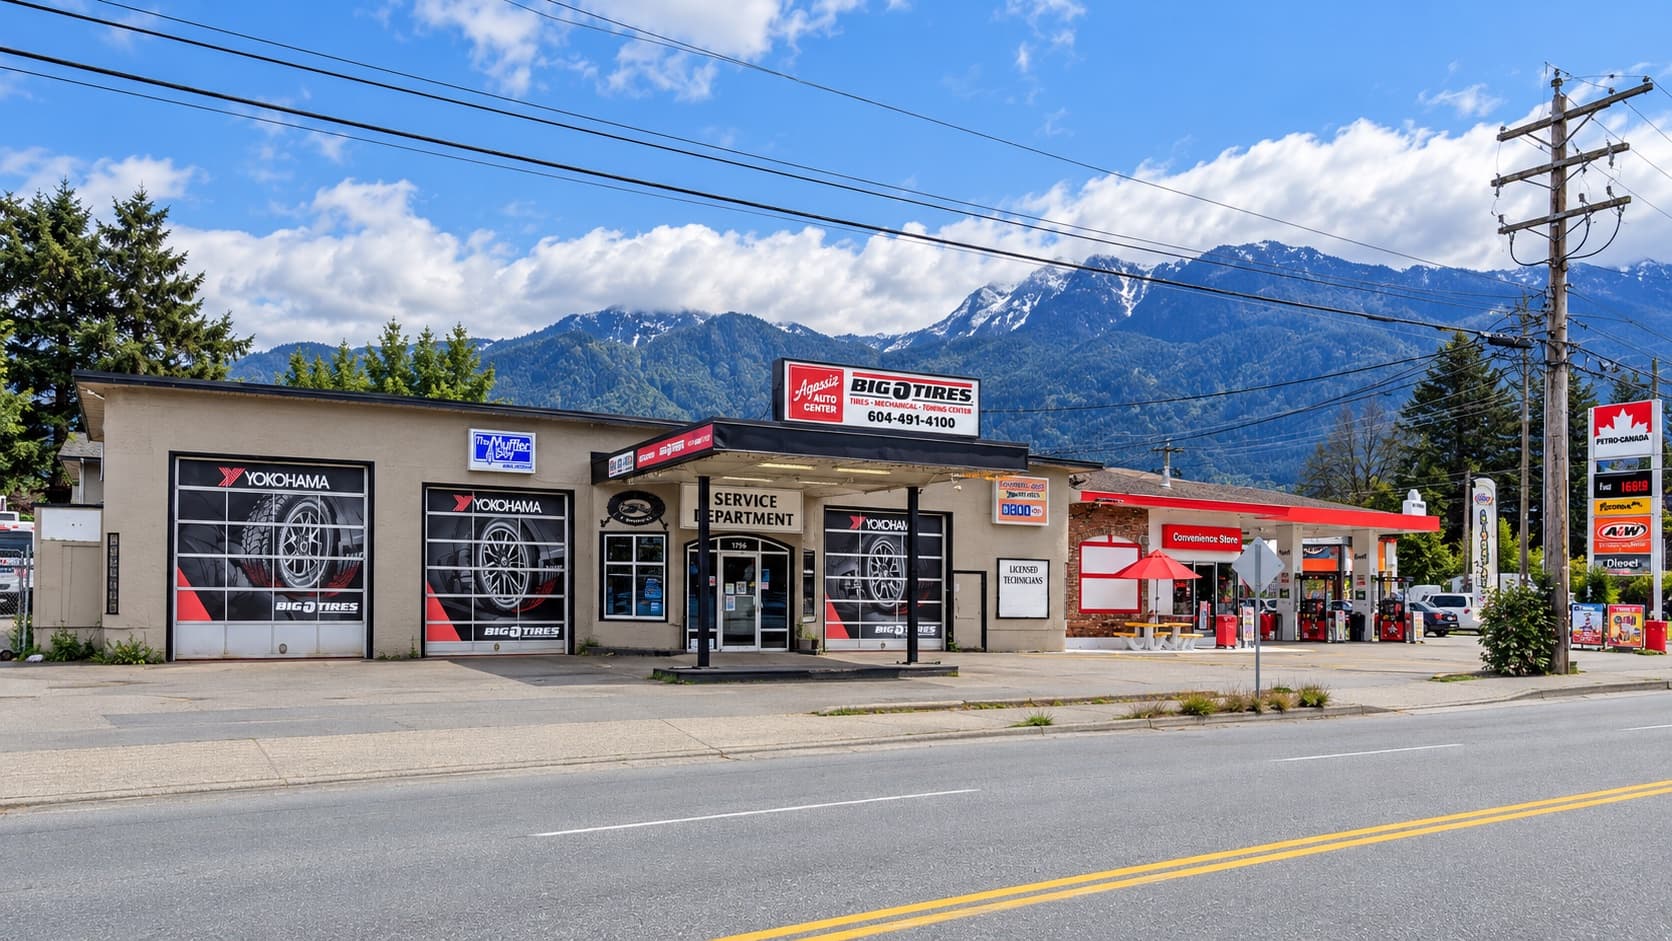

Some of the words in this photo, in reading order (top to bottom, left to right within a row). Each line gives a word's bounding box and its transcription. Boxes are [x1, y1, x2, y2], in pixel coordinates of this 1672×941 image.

[850, 378, 891, 394] BIG
[912, 384, 972, 402] TIRES
[813, 393, 837, 404] AUTO
[803, 402, 837, 414] CENTER
[850, 397, 869, 405] TIRES
[874, 400, 918, 410] MECHANICAL
[948, 407, 972, 415] CENTER
[867, 410, 955, 428] 604-491-4100
[1596, 434, 1649, 445] PETRO-CANADA
[245, 471, 330, 489] YOKOHAMA
[473, 498, 542, 513] YOKOHAMA
[714, 491, 777, 508] SERVICE
[866, 519, 908, 530] YOKOHAM
[1604, 524, 1642, 536] A&W
[1172, 532, 1218, 543] Convenience
[1219, 534, 1238, 544] Store
[1009, 565, 1039, 574] LICENSED
[1003, 575, 1044, 585] TECHNICIANS
[275, 601, 303, 611] BIG
[319, 602, 359, 612] TIRES
[484, 627, 510, 636] BIG
[522, 627, 560, 636] TIRES
[874, 625, 895, 635] BIG
